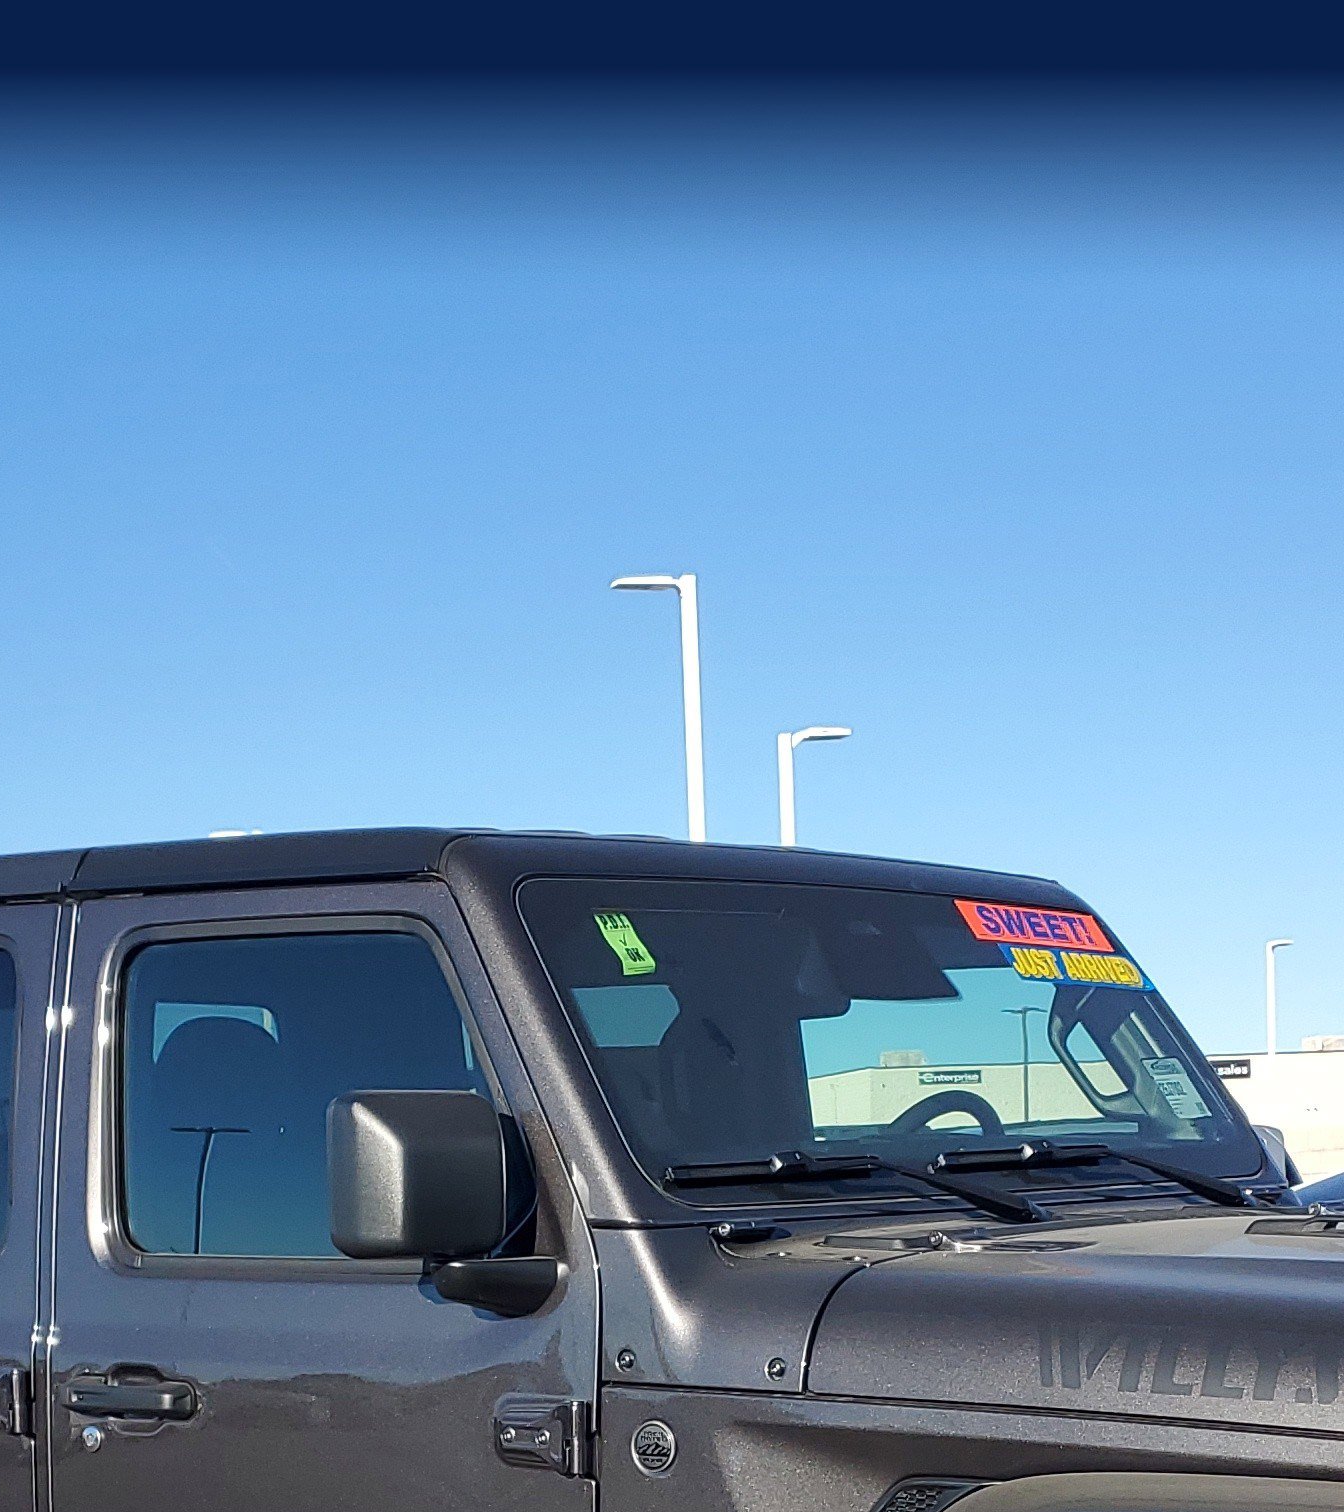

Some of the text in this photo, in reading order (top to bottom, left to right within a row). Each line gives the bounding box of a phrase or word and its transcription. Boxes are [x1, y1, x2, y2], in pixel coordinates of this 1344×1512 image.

[974, 905, 1096, 946] SWEET!
[1010, 947, 1144, 989] JUST ARRIVED
[1217, 1063, 1248, 1076] sales
